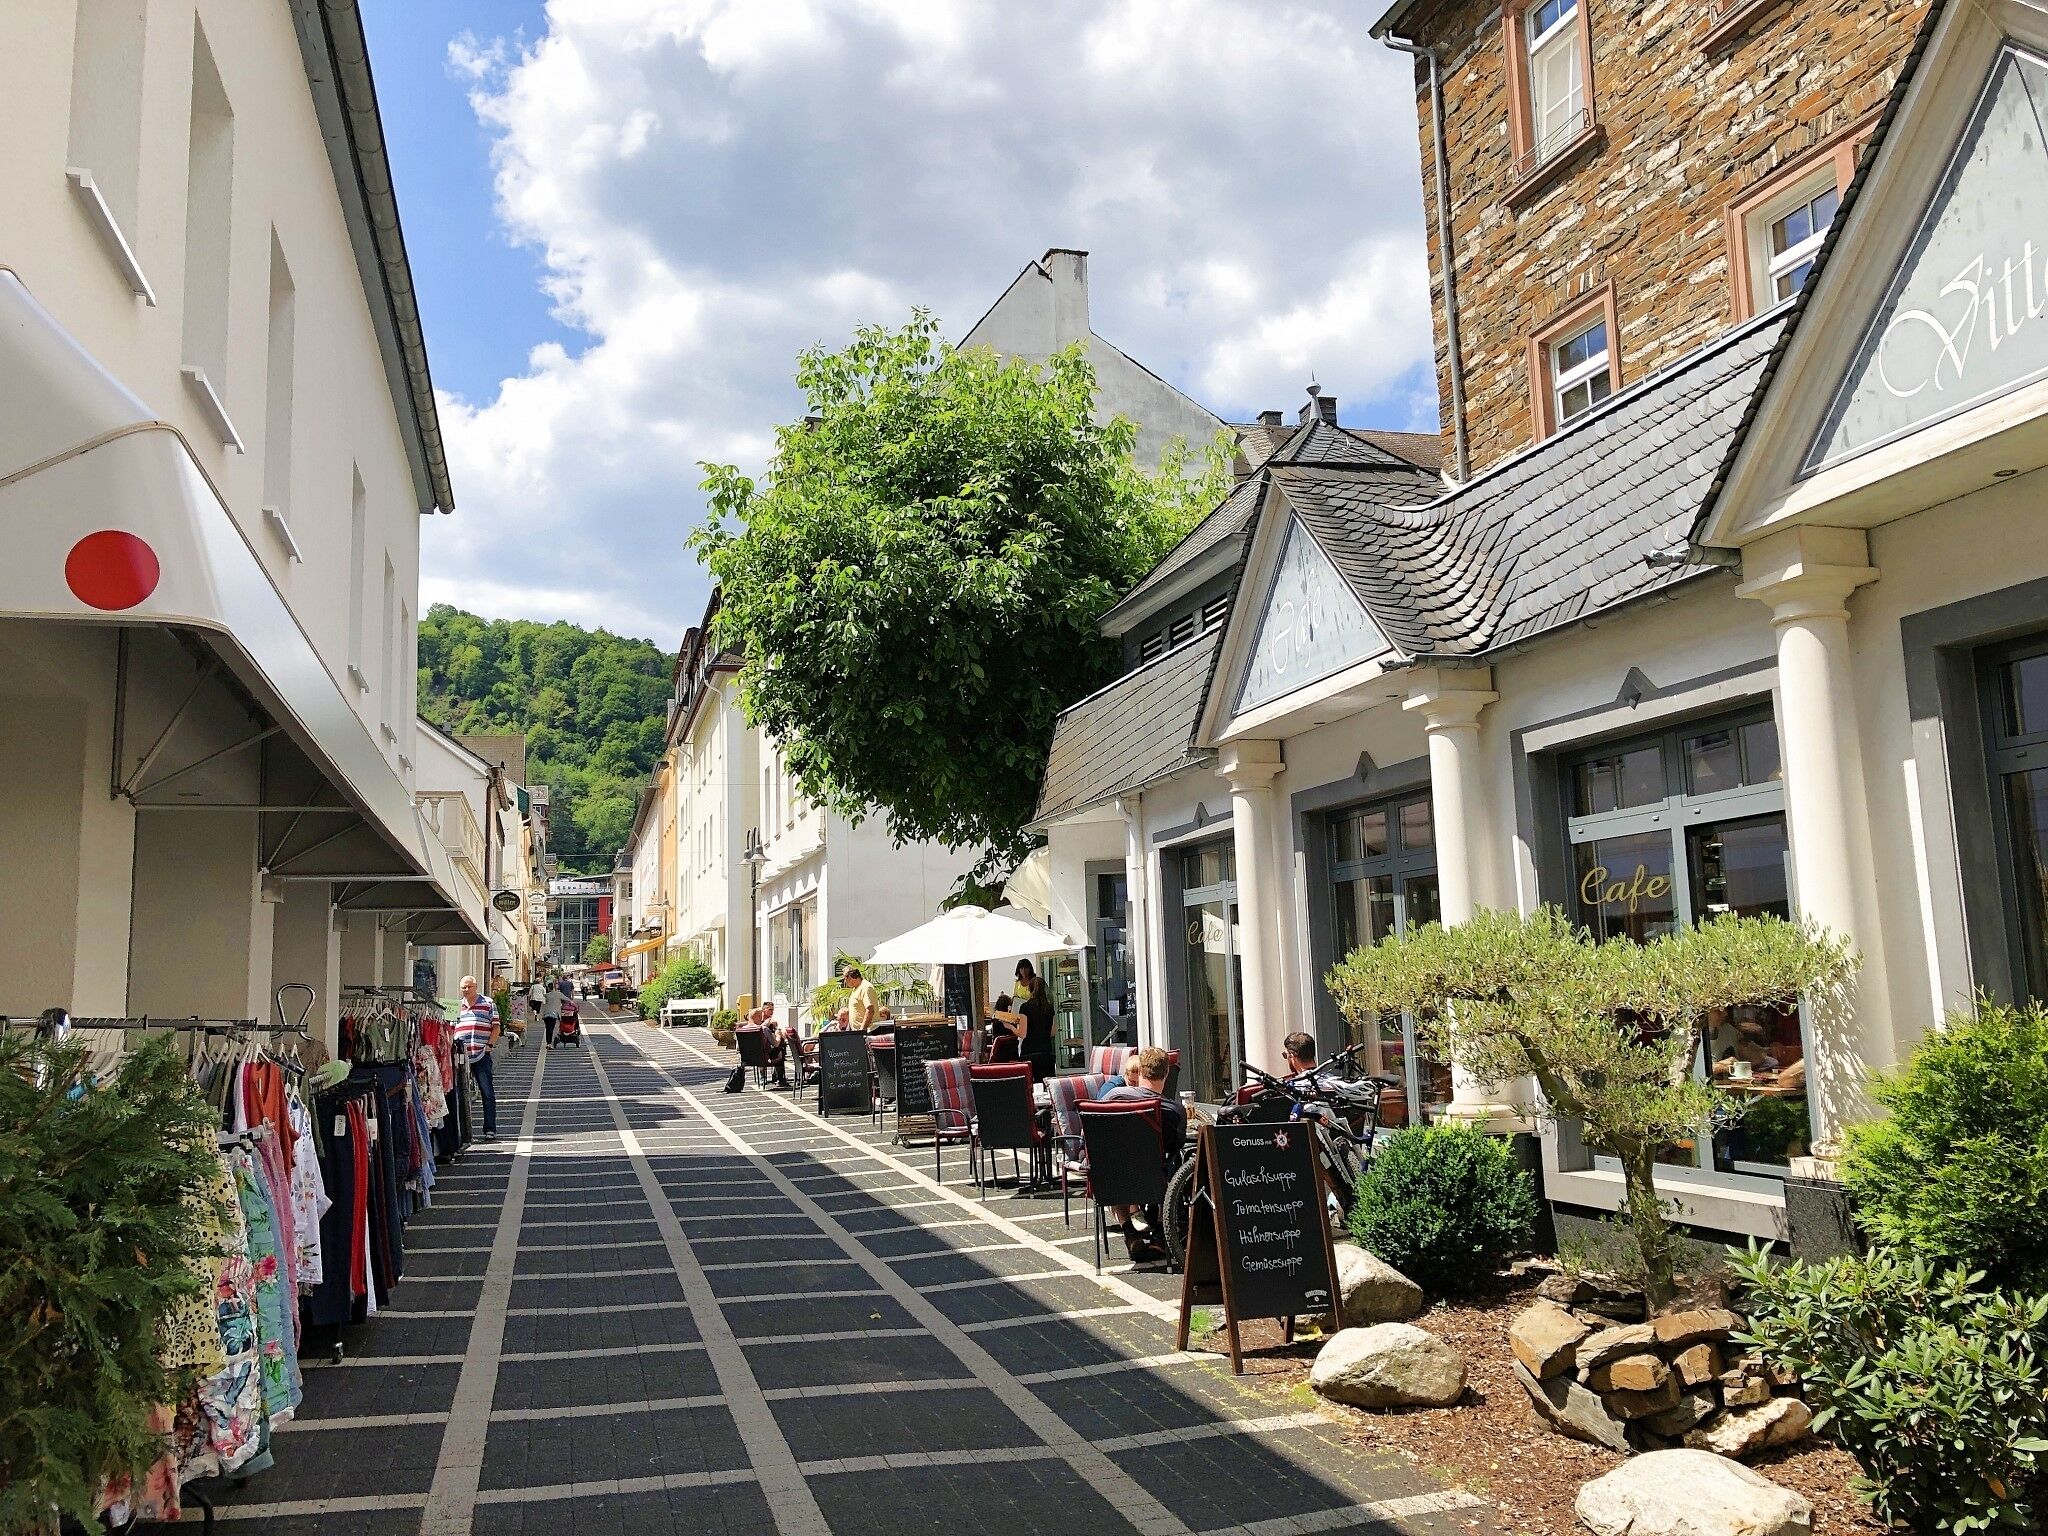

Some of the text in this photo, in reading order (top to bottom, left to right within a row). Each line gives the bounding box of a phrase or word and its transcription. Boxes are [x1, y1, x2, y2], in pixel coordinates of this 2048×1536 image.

[1878, 239, 2048, 398] Vitt
[1580, 863, 1673, 914] Cafe
[1232, 1137, 1265, 1147] Genuss
[1224, 1166, 1297, 1192] Gulaschsuppe
[1232, 1199, 1304, 1224] Tomatensuppe
[1238, 1226, 1301, 1250] Hühnersuppe
[1241, 1255, 1303, 1277] Gemüsesuppe
